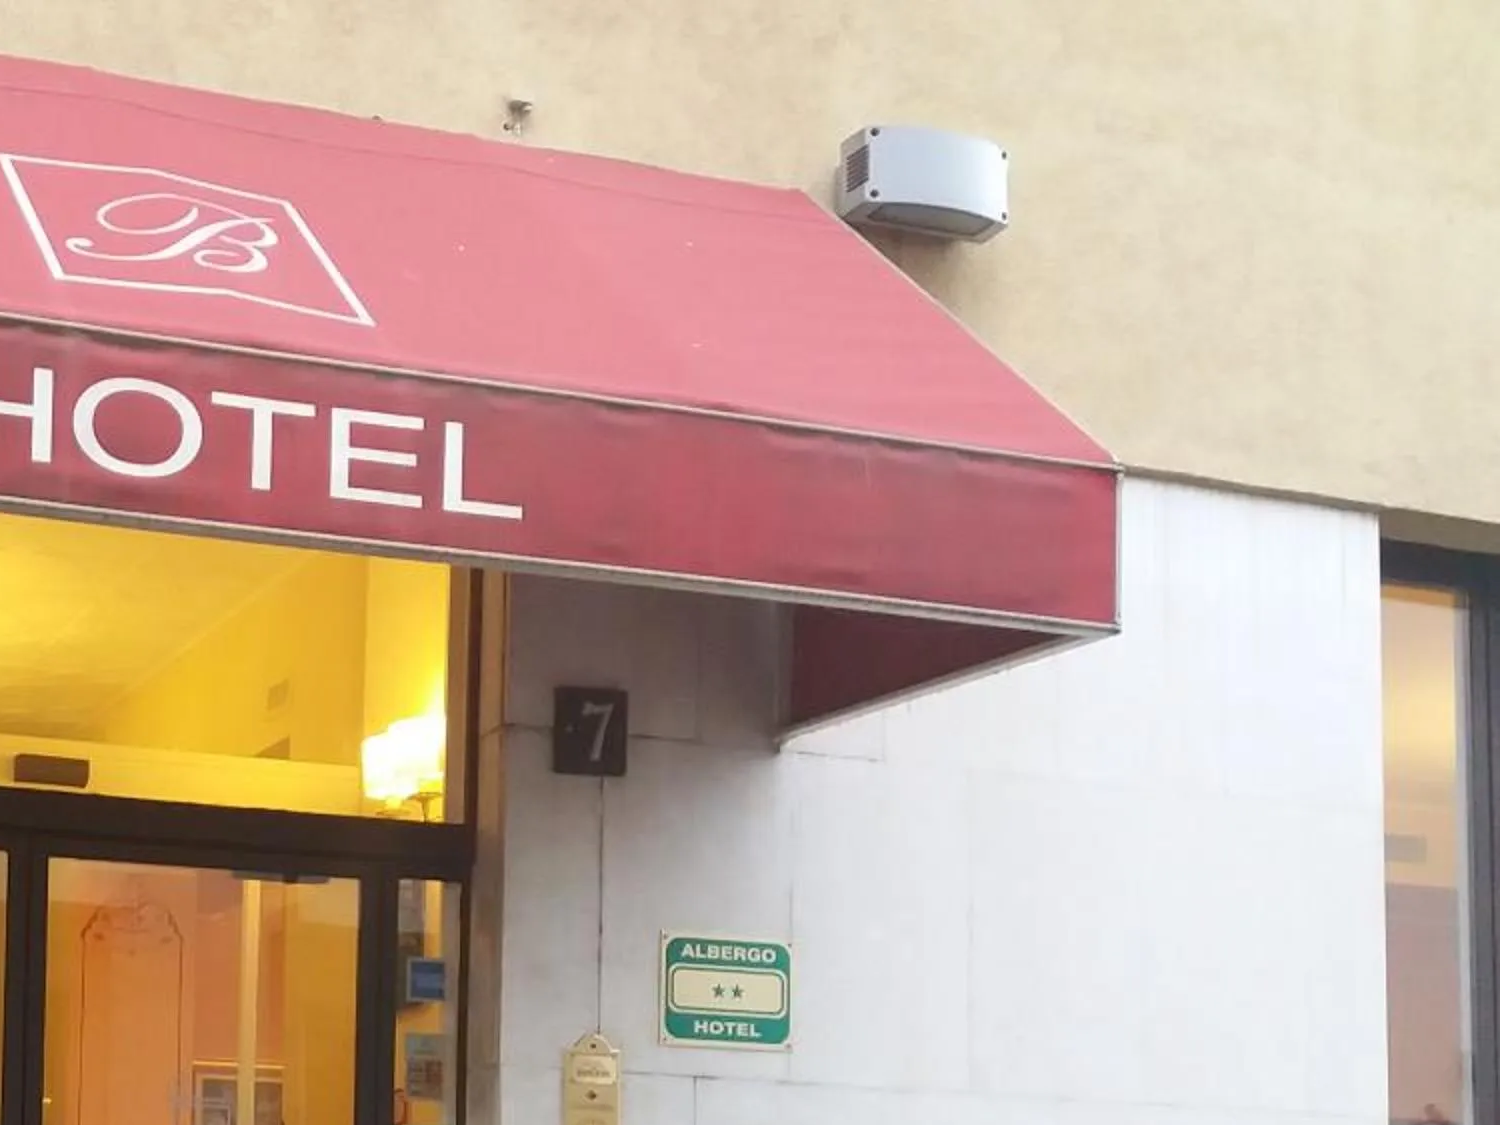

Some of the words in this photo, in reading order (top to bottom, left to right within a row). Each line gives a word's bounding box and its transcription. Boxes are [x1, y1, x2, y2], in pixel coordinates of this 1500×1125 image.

[582, 701, 615, 762] 7
[681, 943, 777, 963] ALBERGO
[693, 1019, 762, 1037] HOTEL
